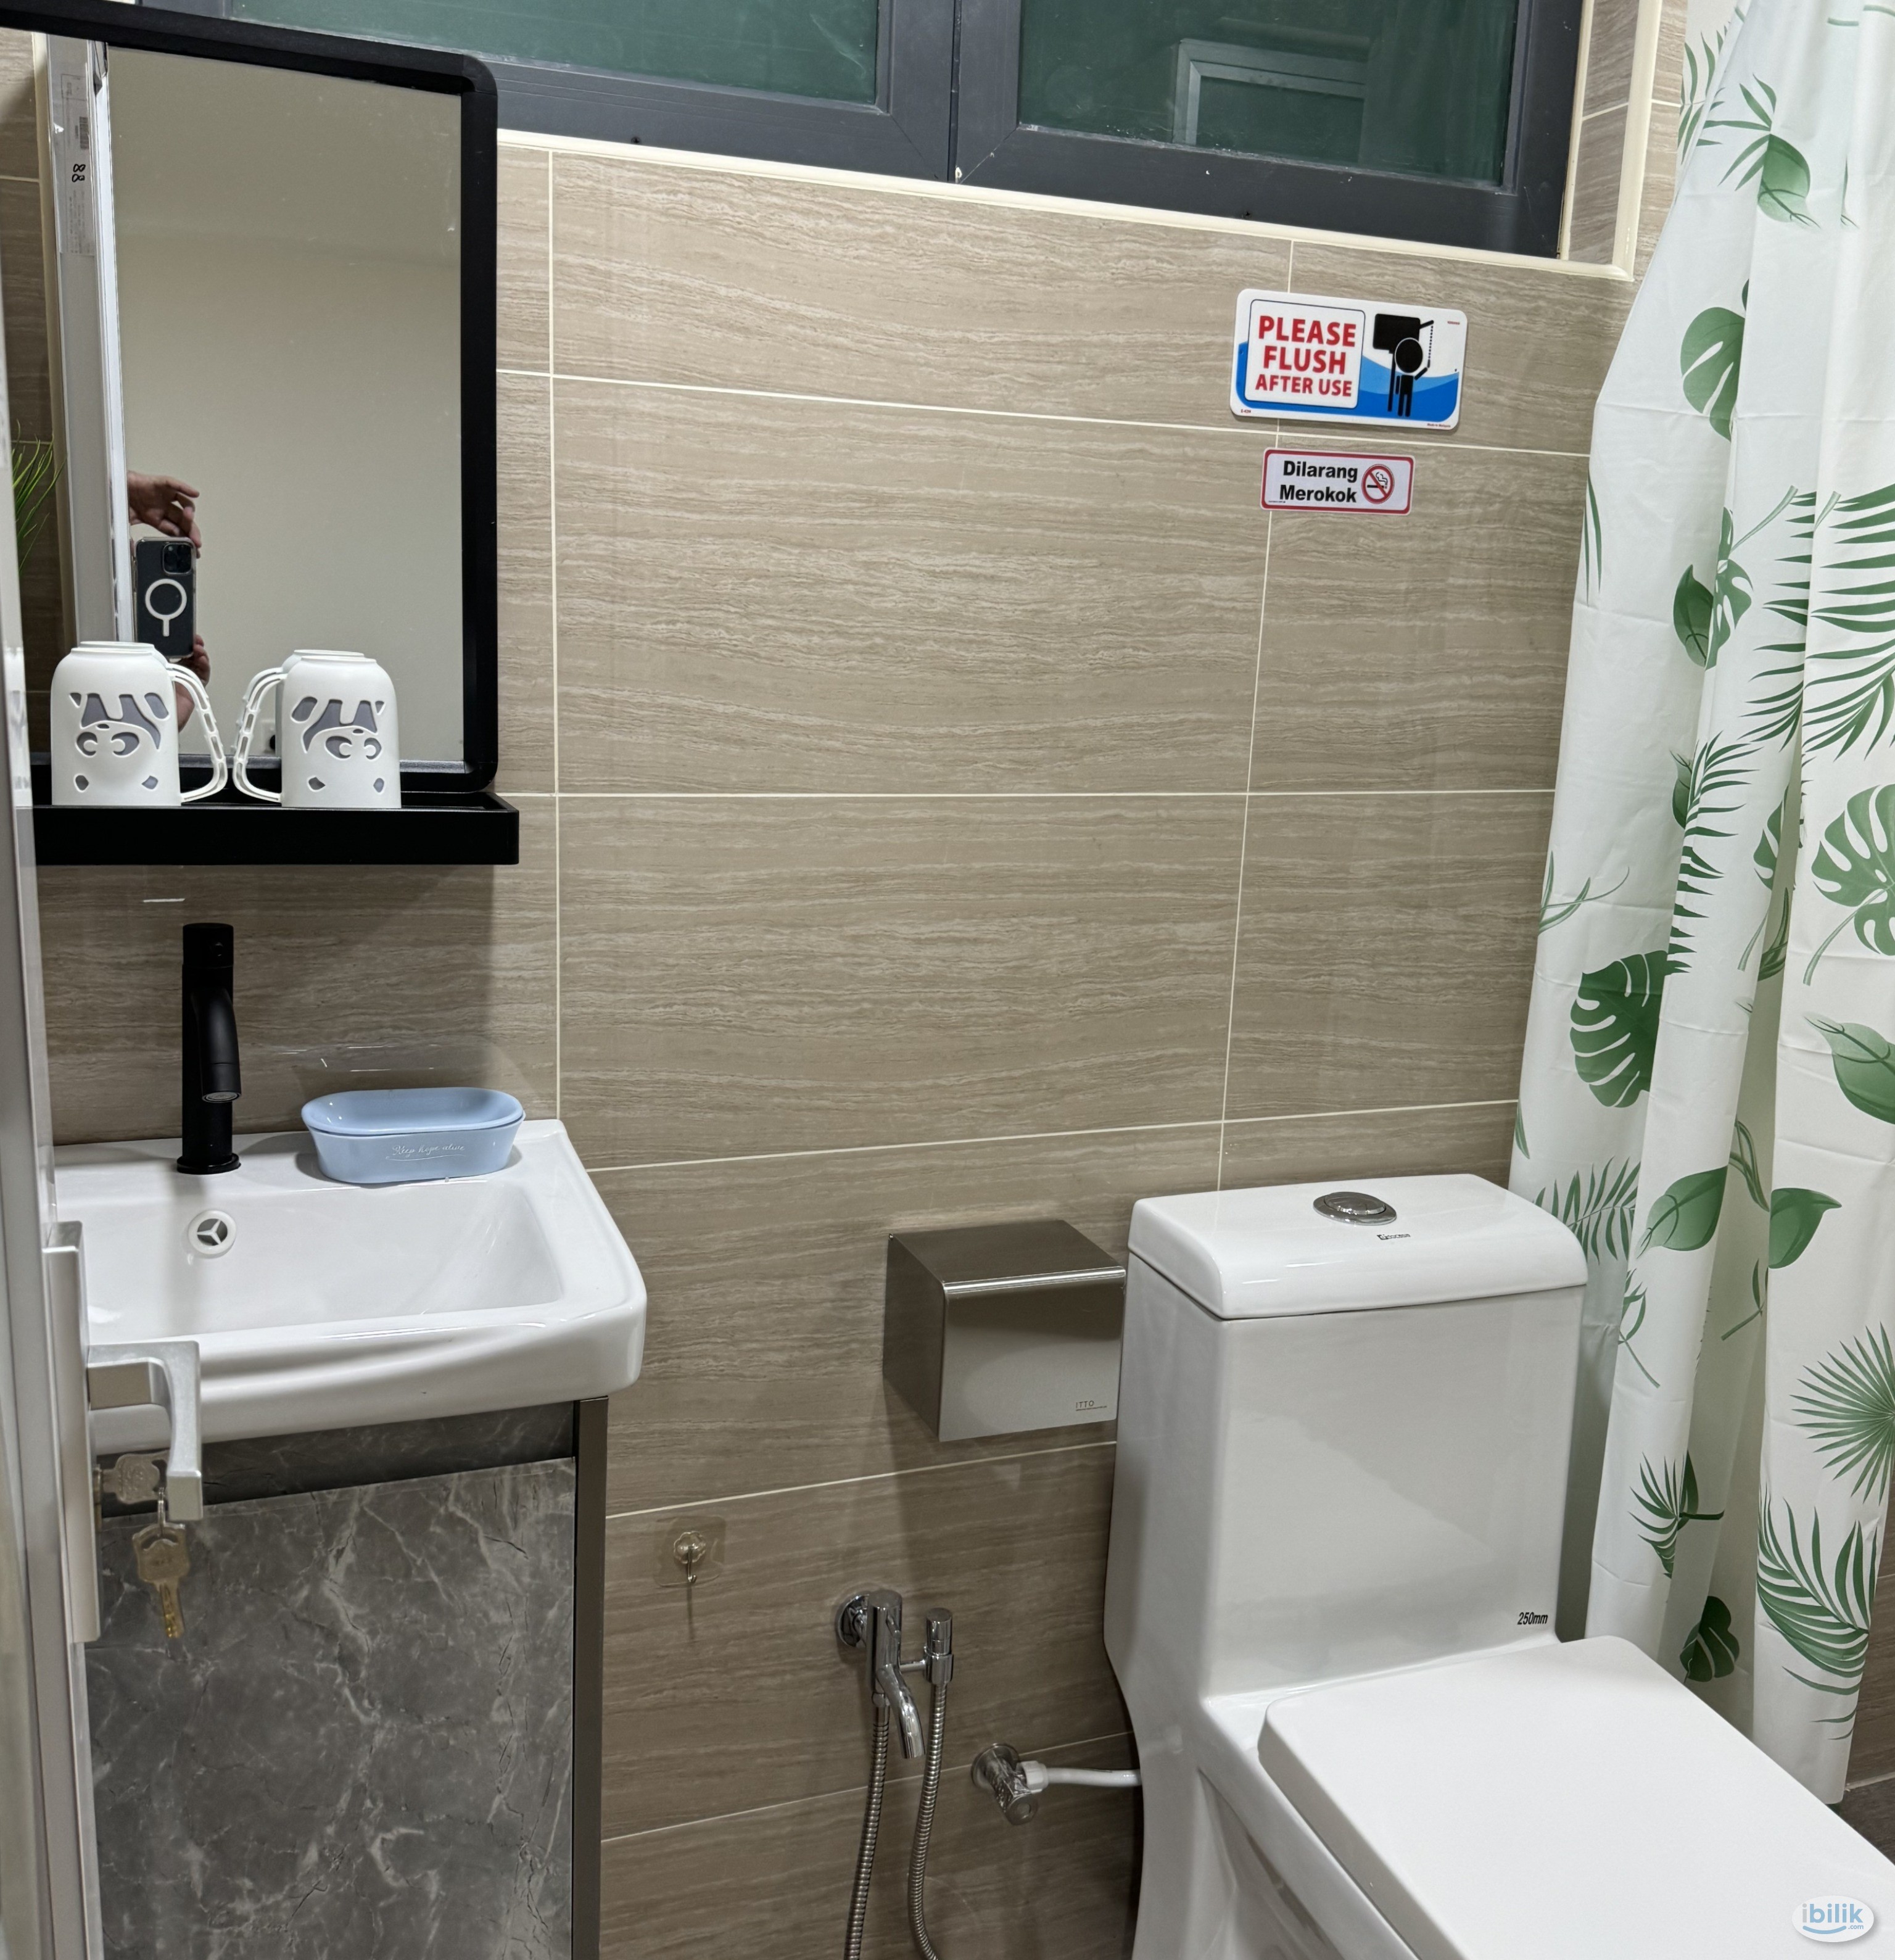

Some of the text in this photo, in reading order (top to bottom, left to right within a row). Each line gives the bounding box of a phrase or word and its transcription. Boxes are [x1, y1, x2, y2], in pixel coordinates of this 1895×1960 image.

[1258, 315, 1356, 347] PLEASE
[1263, 345, 1346, 375] FLUSH
[1255, 374, 1352, 397] AFTER USE
[1283, 460, 1358, 484] Dilarang
[1279, 484, 1357, 503] Merokok
[418, 1144, 440, 1156] hope
[1075, 1400, 1094, 1408] ITTO
[1517, 1611, 1548, 1625] 250mm
